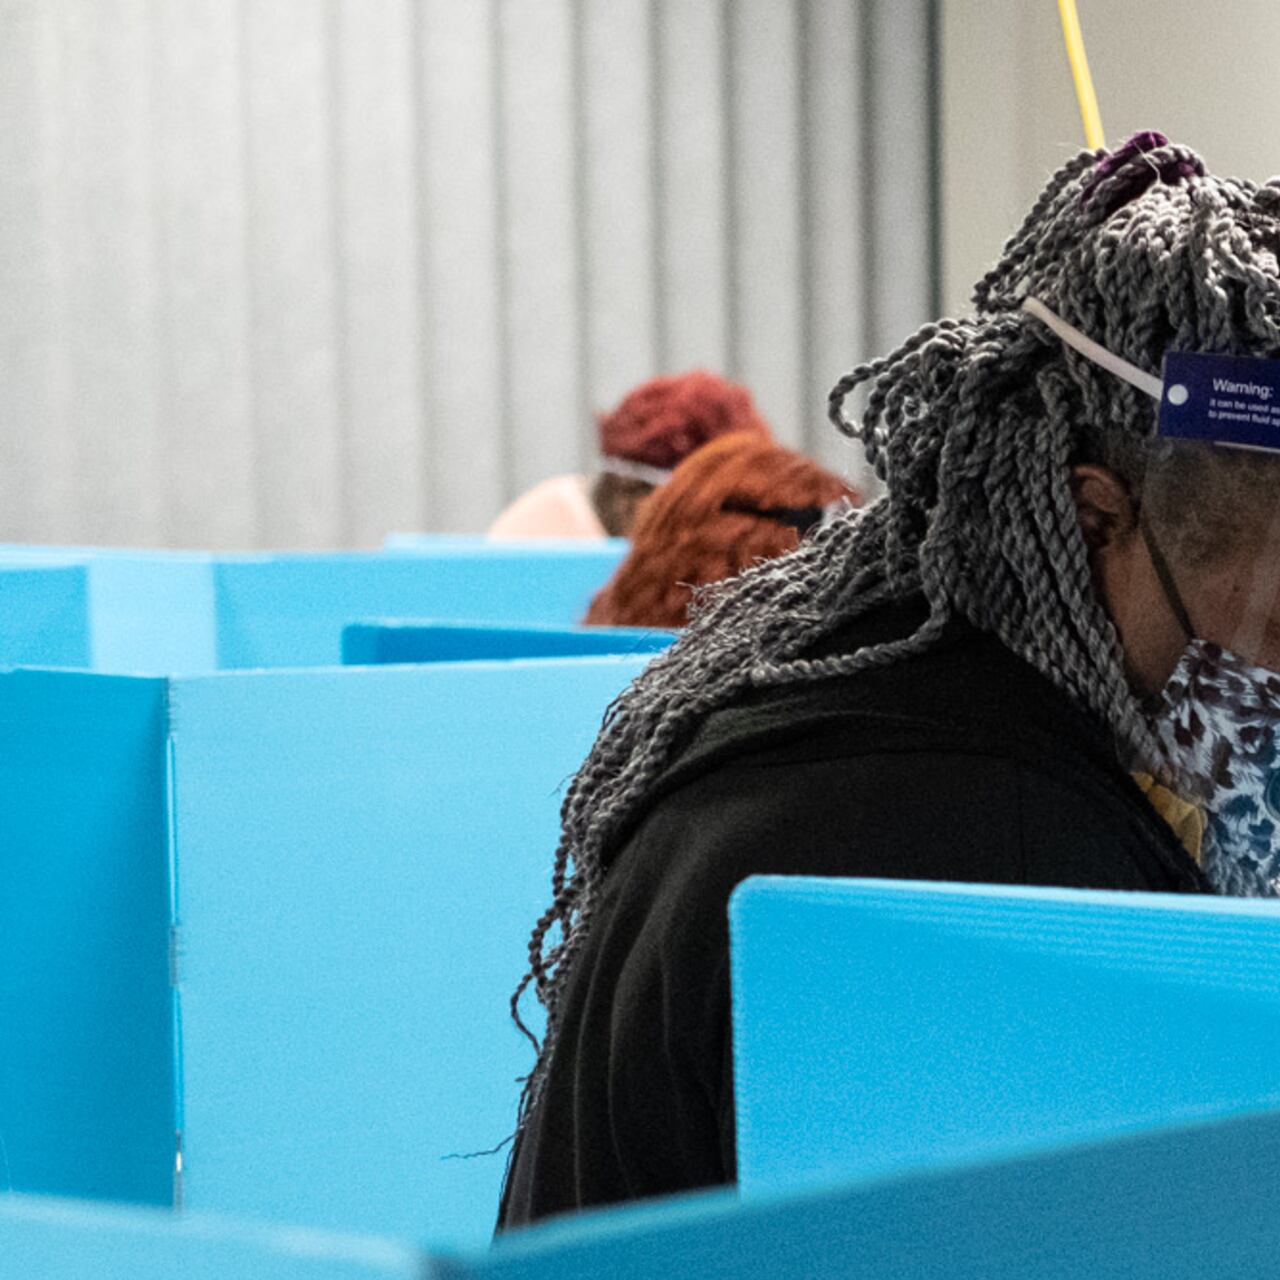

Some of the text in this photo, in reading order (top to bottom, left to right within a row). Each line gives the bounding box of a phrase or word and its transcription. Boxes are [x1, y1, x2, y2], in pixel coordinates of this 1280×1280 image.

[1213, 378, 1274, 400] Warning:
[1217, 400, 1233, 409] can
[1234, 400, 1246, 410] be
[1247, 403, 1270, 413] used
[1270, 406, 1280, 415] as
[1208, 409, 1217, 419] to
[1218, 411, 1250, 423] prevent
[1251, 413, 1270, 425] fluid
